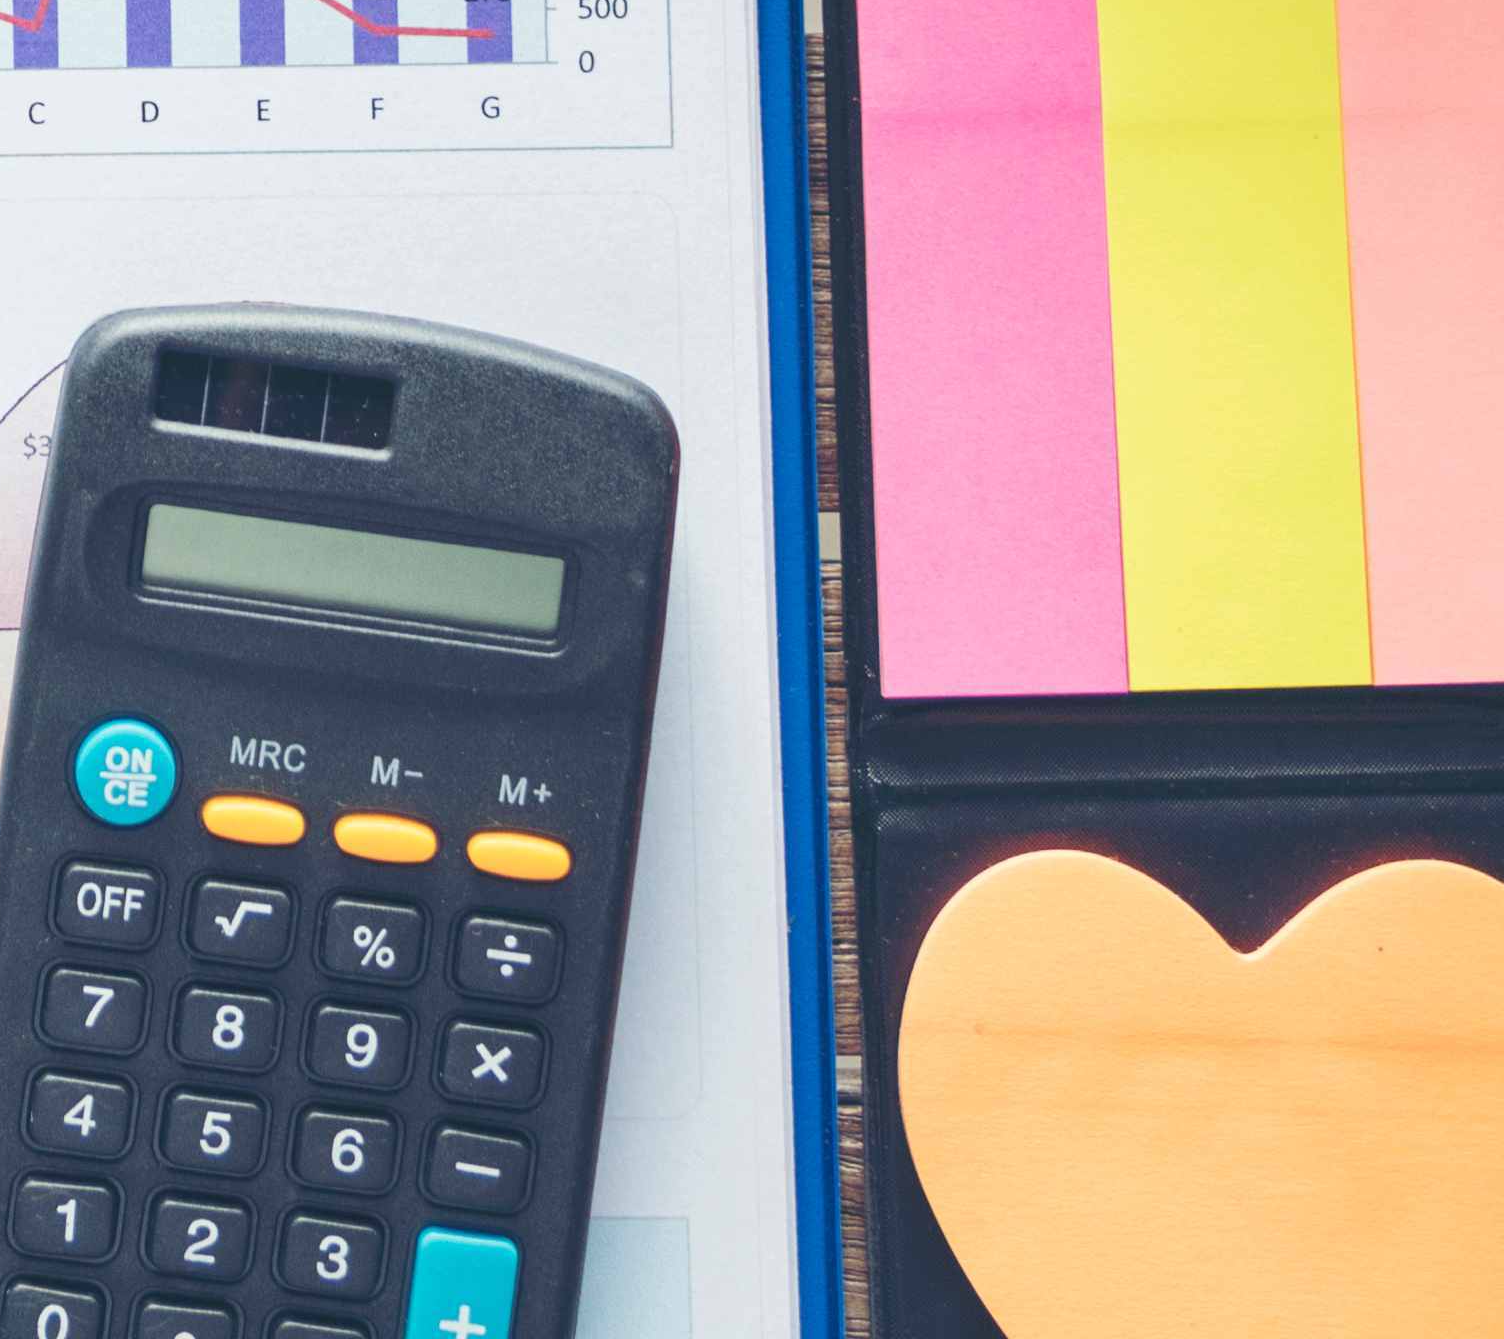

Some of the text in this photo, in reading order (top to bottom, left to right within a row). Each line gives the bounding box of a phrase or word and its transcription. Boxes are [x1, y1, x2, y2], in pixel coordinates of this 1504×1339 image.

[578, 50, 596, 75] 0
[28, 102, 45, 125] C
[141, 101, 159, 123] D
[257, 99, 270, 121] E
[371, 98, 383, 120] F
[481, 96, 500, 119] G
[105, 746, 154, 776] ON
[230, 736, 306, 772] MRC
[104, 780, 148, 808] CE
[77, 882, 144, 921] OFF
[83, 986, 377, 1068] 7 8 9
[64, 1095, 363, 1172] 4 5 6
[57, 1199, 348, 1279] 1 2 3
